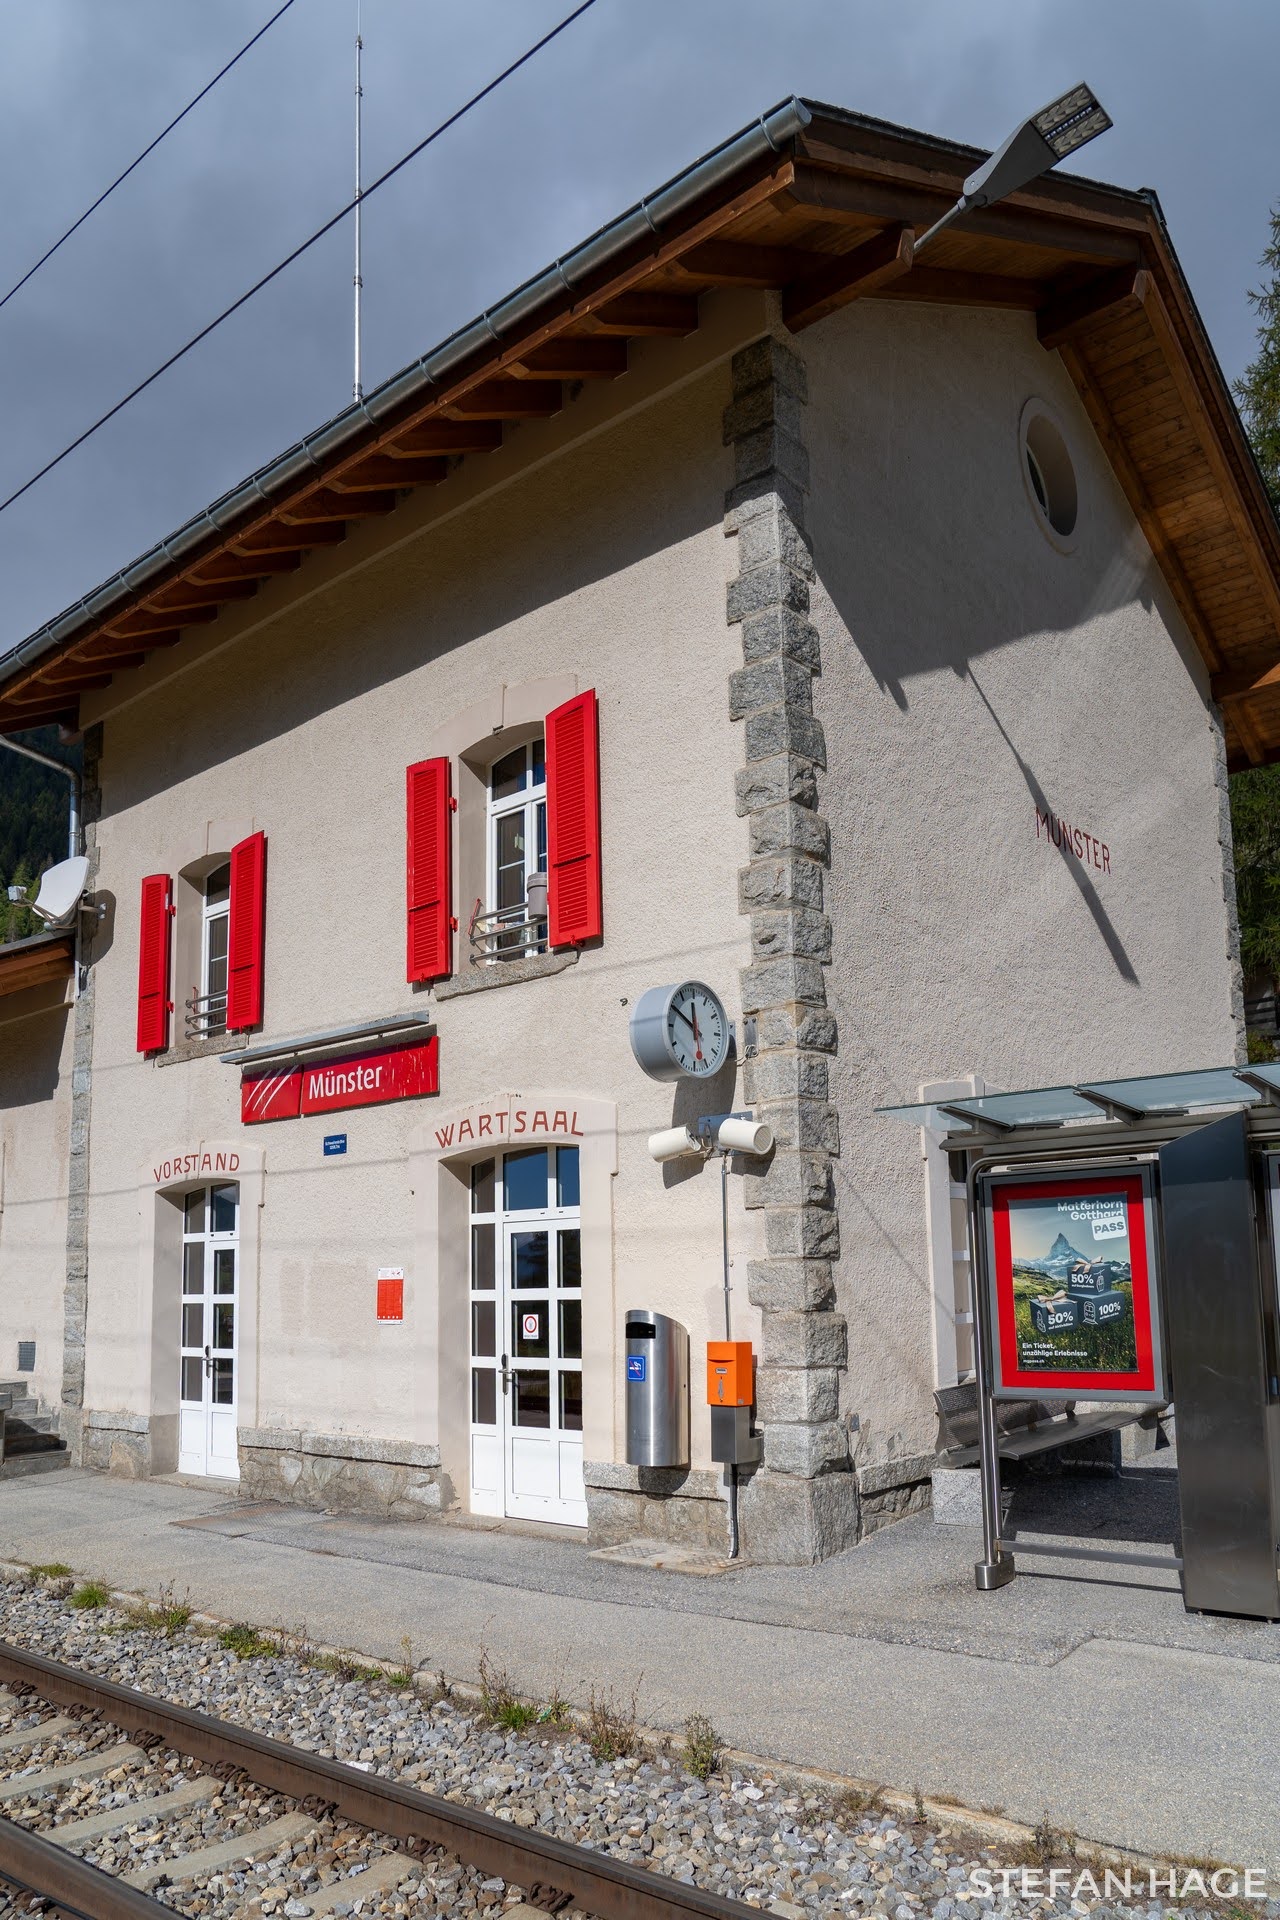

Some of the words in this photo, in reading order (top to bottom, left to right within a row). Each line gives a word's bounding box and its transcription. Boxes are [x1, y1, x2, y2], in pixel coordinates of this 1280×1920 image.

[1035, 806, 1111, 874] MÜNSTER
[309, 1065, 383, 1099] Münster
[435, 1111, 584, 1148] WARTSAAL
[154, 1153, 240, 1182] VORSTAND
[1057, 1200, 1124, 1212] Matterhorn
[1070, 1208, 1124, 1221] Gotthard
[1093, 1221, 1125, 1234] PASS
[1071, 1273, 1094, 1284] 50%
[1098, 1301, 1121, 1316] 100%
[1048, 1311, 1074, 1325] 50%
[1022, 1349, 1053, 1357] unzählige
[1054, 1349, 1088, 1357] Erlebnisse
